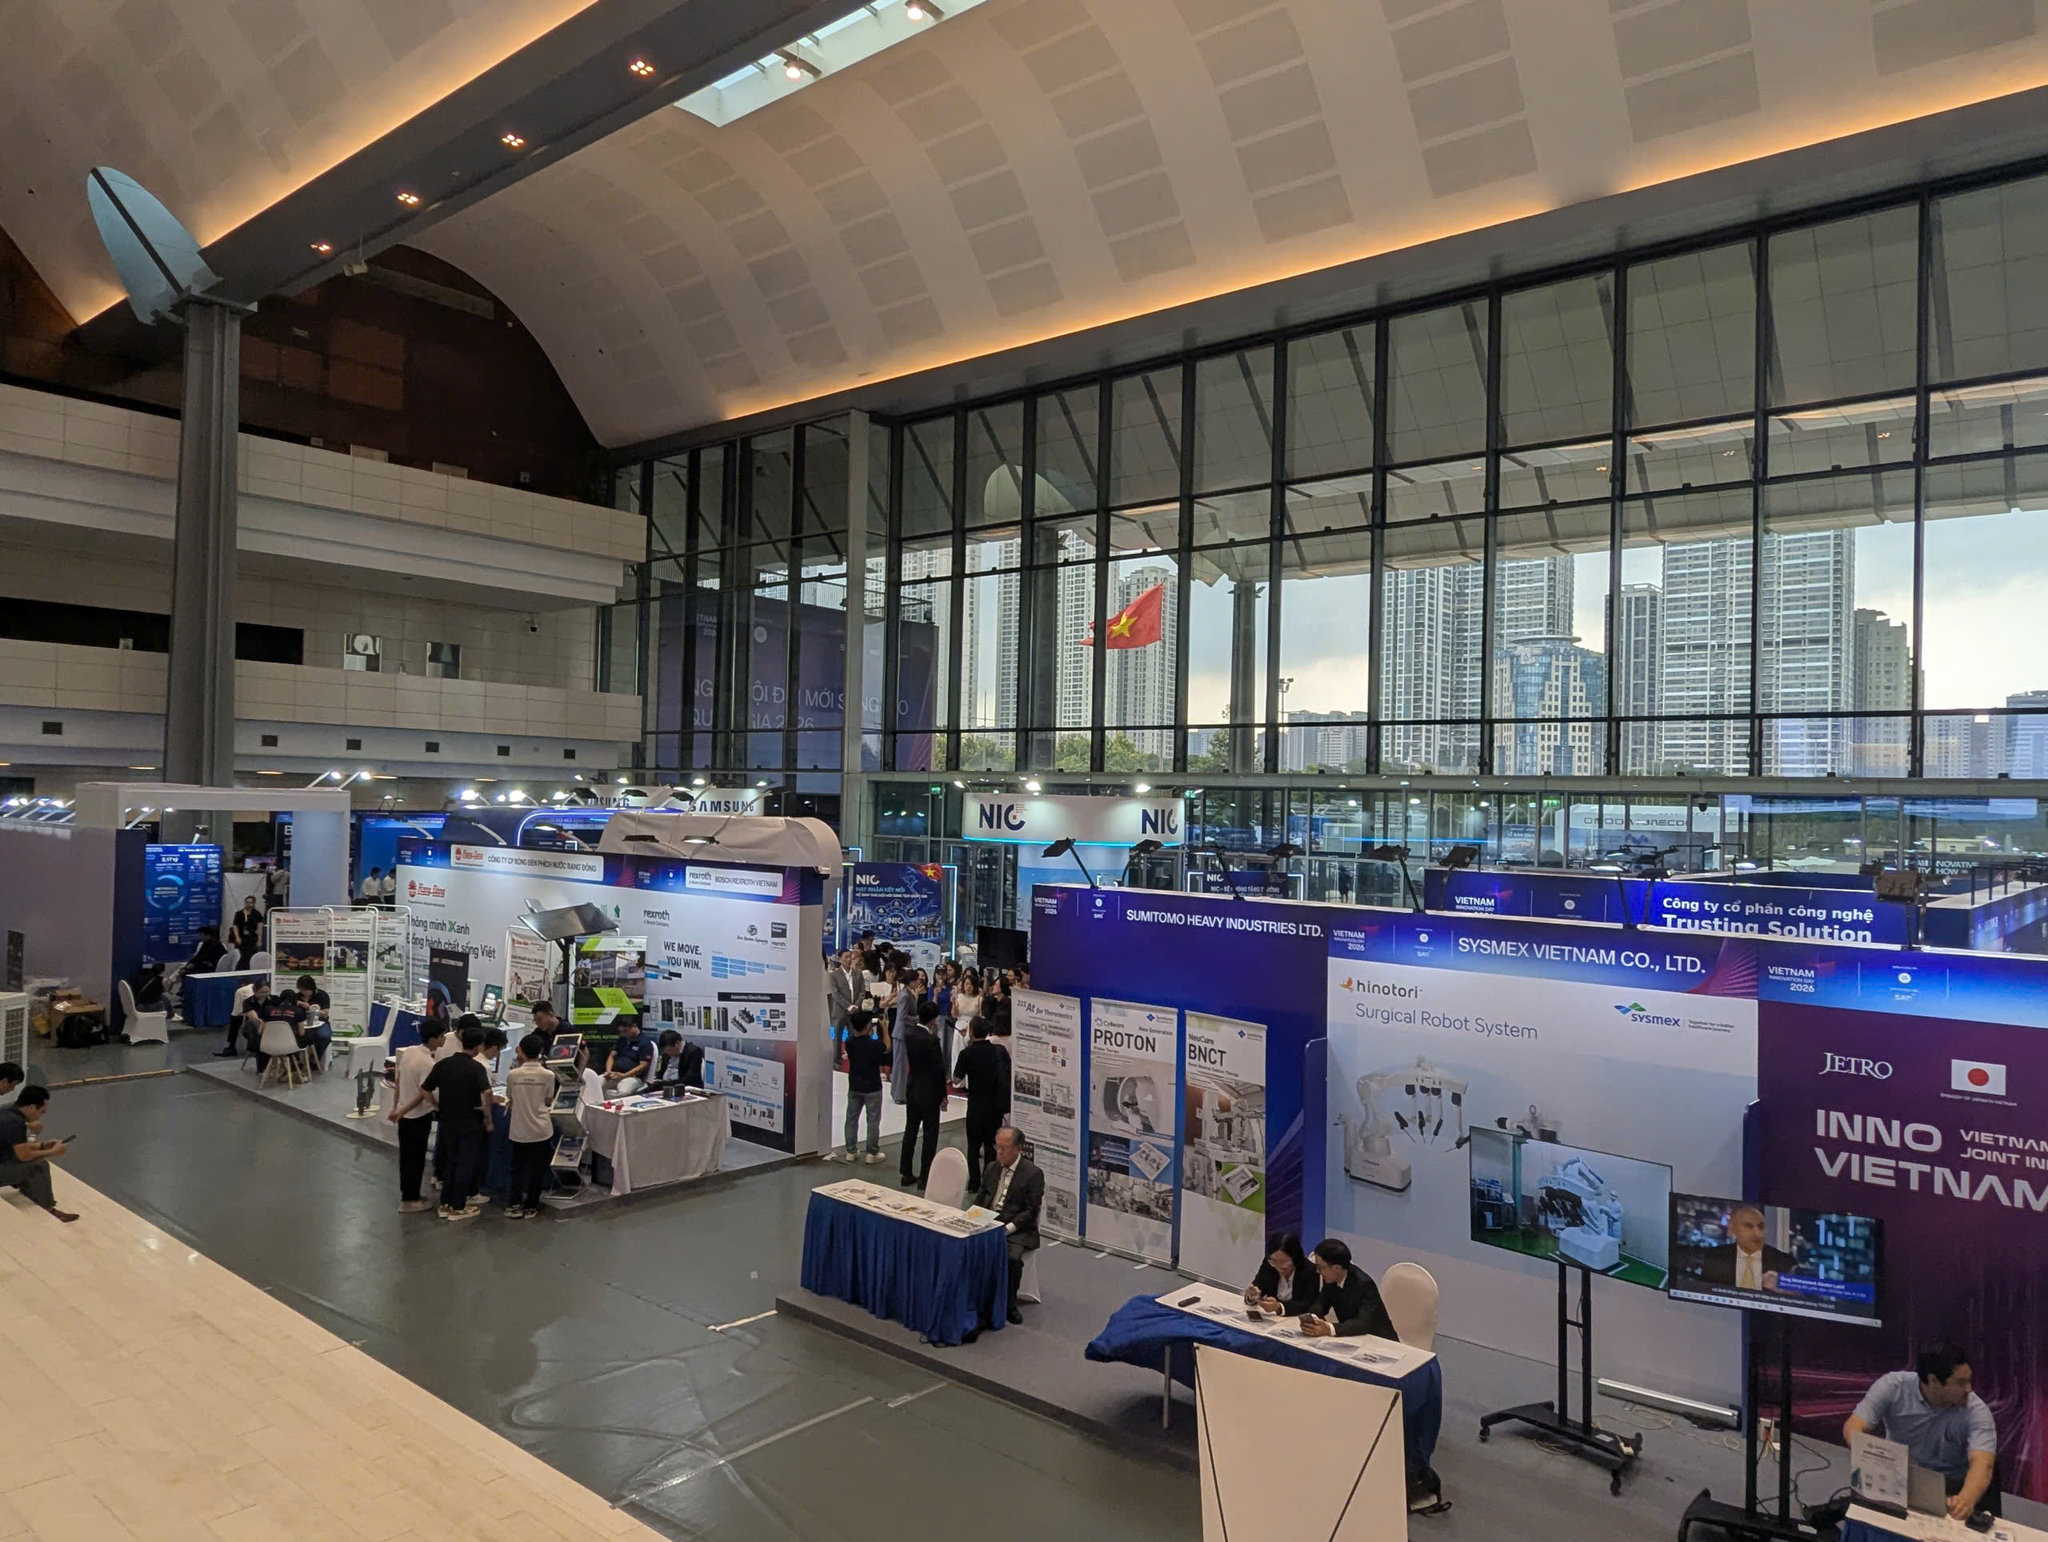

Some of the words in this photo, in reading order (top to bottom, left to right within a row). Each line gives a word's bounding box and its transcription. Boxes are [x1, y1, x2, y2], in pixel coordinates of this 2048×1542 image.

[805, 687, 834, 708] MỚI
[690, 800, 754, 812] SAMSUNG
[979, 803, 1026, 830] NIC
[1141, 809, 1178, 835] NIC
[689, 871, 711, 880] rexroth
[715, 876, 731, 884] BOSCH
[732, 877, 755, 886] REXROTH
[756, 880, 778, 888] VIETNAM
[856, 875, 880, 885] NIC
[1207, 874, 1224, 882] NIC
[1034, 897, 1057, 905] VIETNAM
[1455, 896, 1494, 906] VIETNAM
[644, 909, 670, 920] rexroth
[1663, 897, 1699, 912] Công
[1704, 902, 1719, 914] ty
[1723, 900, 1740, 913] cổ
[1745, 902, 1783, 918] phần
[1788, 905, 1827, 921] công
[1832, 907, 1874, 923] nghệ
[429, 919, 446, 931] minh
[448, 920, 470, 934] Xanh
[1126, 909, 1185, 925] SUMITOMO
[1187, 915, 1223, 928] HEAVY
[1226, 917, 1296, 935] INDUSTRIES
[1298, 924, 1324, 937] LTD.
[1662, 913, 1759, 935] Trusting
[1768, 921, 1872, 943] Solution
[1333, 929, 1365, 939] VIETNAM
[480, 944, 496, 962] Việt
[663, 941, 676, 952] WE
[677, 942, 702, 956] MOVE.
[1348, 943, 1365, 951] 2026
[1458, 937, 1529, 958] SYSMEX
[1533, 943, 1615, 965] VIETNAM
[1620, 951, 1659, 971] CO.,
[1666, 955, 1706, 973] LTD.
[667, 956, 682, 967] YOU
[684, 958, 702, 970] WIN.
[1768, 966, 1814, 978] VIETNAM
[1357, 979, 1418, 998] hinotori
[1790, 983, 1815, 992] 2026
[1356, 1003, 1416, 1026] Surgical
[1421, 1012, 1470, 1031] Robot
[1474, 1018, 1538, 1040] System
[1631, 1013, 1681, 1028] sysmex
[1094, 1028, 1156, 1053] PROTON
[1188, 1034, 1214, 1045] NeuCure
[1188, 1044, 1227, 1067] BNCT
[1819, 1052, 1893, 1079] JETRO
[1816, 1109, 1942, 1152] INNO
[1960, 1147, 2020, 1165] JOINT
[1814, 1147, 2048, 1212] VIETNAM
